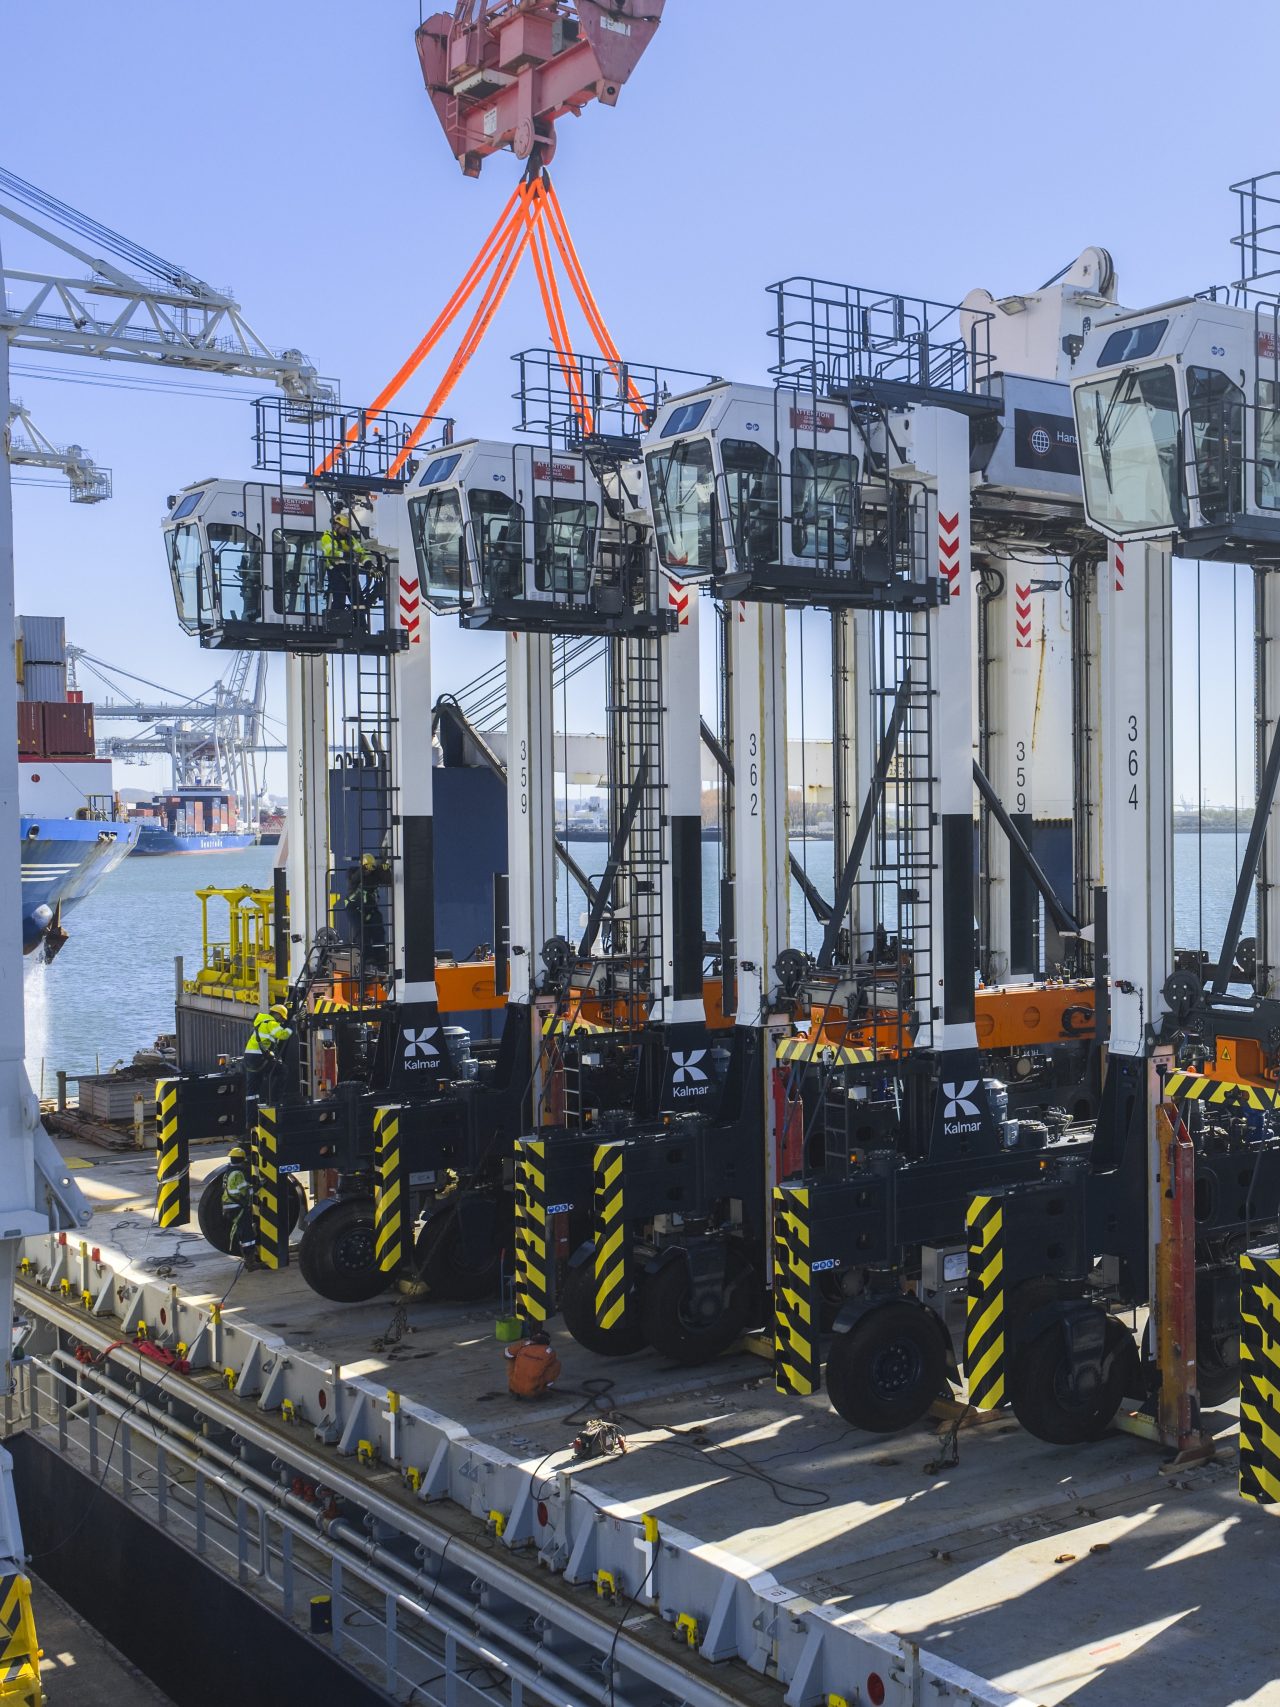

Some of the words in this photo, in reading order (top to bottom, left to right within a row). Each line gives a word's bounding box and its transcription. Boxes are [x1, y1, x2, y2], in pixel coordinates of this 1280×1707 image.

[275, 497, 309, 505] ATENTION
[1127, 715, 1139, 811] 364
[749, 733, 758, 816] 362
[1016, 741, 1026, 813] 359
[404, 1059, 440, 1071] Kalmar
[672, 1086, 709, 1098] Kalmar
[944, 1121, 981, 1135] Kalmar
